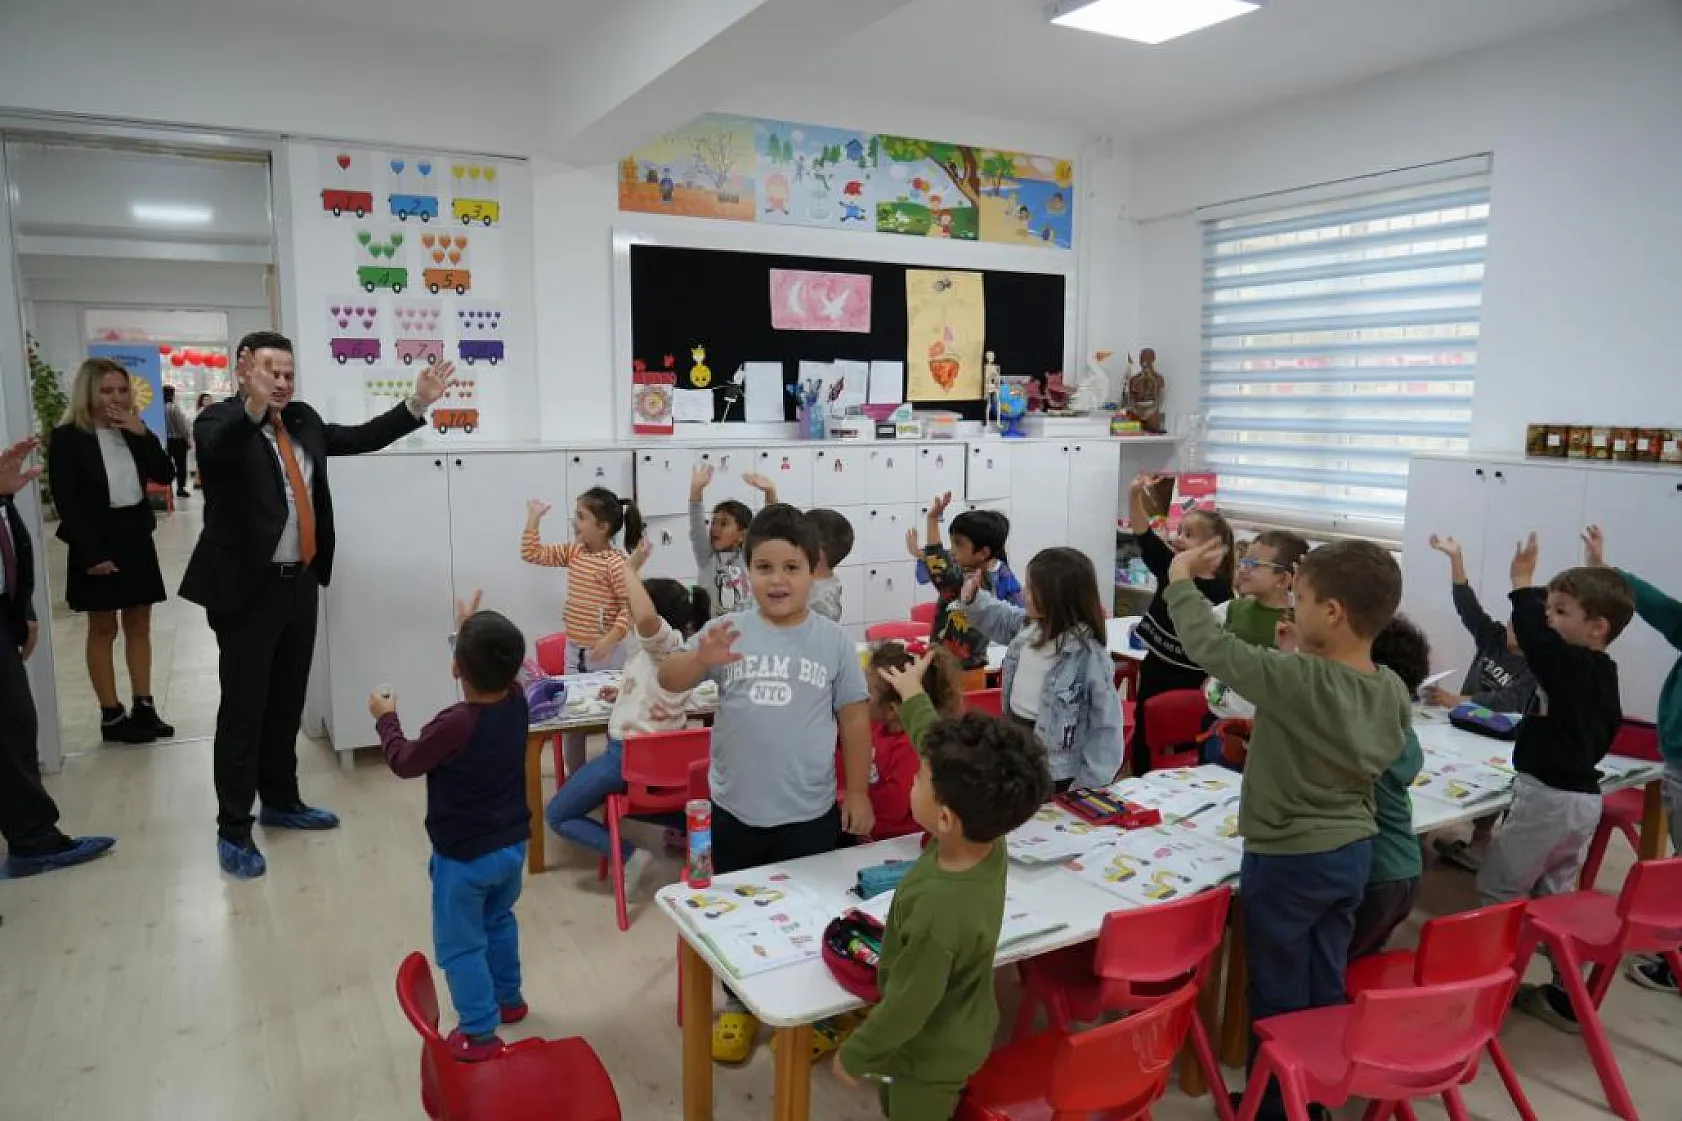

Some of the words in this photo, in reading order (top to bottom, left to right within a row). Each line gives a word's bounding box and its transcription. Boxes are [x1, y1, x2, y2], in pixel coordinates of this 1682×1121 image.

[410, 199, 421, 214] 2
[470, 203, 483, 219] 3
[443, 272, 454, 287] 5
[416, 343, 428, 357] 7
[450, 413, 467, 424] 10
[798, 657, 828, 689] BIG
